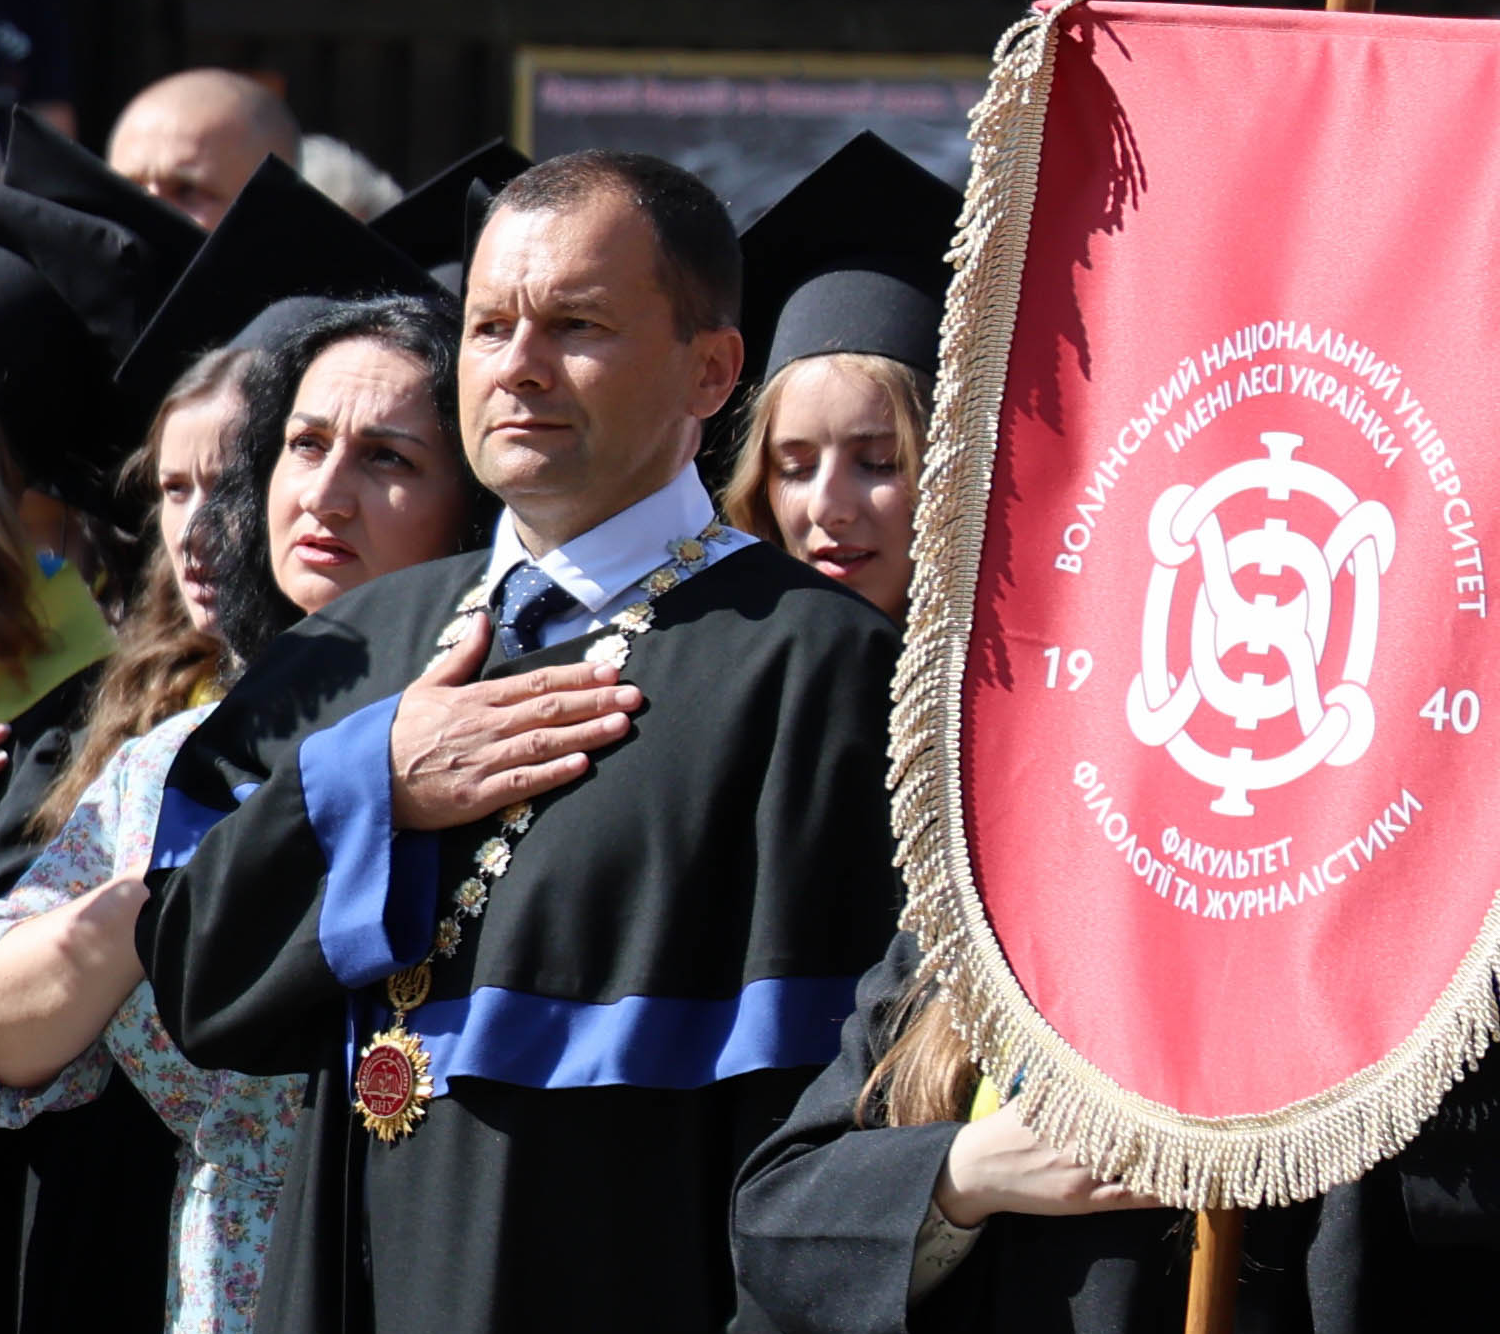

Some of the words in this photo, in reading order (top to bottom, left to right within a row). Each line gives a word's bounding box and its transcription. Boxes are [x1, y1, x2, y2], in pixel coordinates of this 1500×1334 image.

[1163, 387, 1233, 453] ІМЕНІ
[1235, 364, 1283, 399] ЛЕСІ
[1288, 365, 1403, 469] УКРАЇНКИ
[1054, 356, 1202, 575] ВОЛИНСЬКИЙ
[1201, 320, 1403, 402] НАЦІОНАЛЬНИЙ
[1393, 387, 1486, 618] УНІВЕРСИТЕТ
[1043, 646, 1094, 692] 19
[1418, 686, 1481, 735] 40
[1072, 760, 1176, 898] ФІЛОЛОГІЇ
[1173, 879, 1199, 915] ТА
[1202, 788, 1424, 920] ЖУРНАЛІСТИКИ
[1160, 826, 1293, 880] ФАКУЛЬТЕТ
